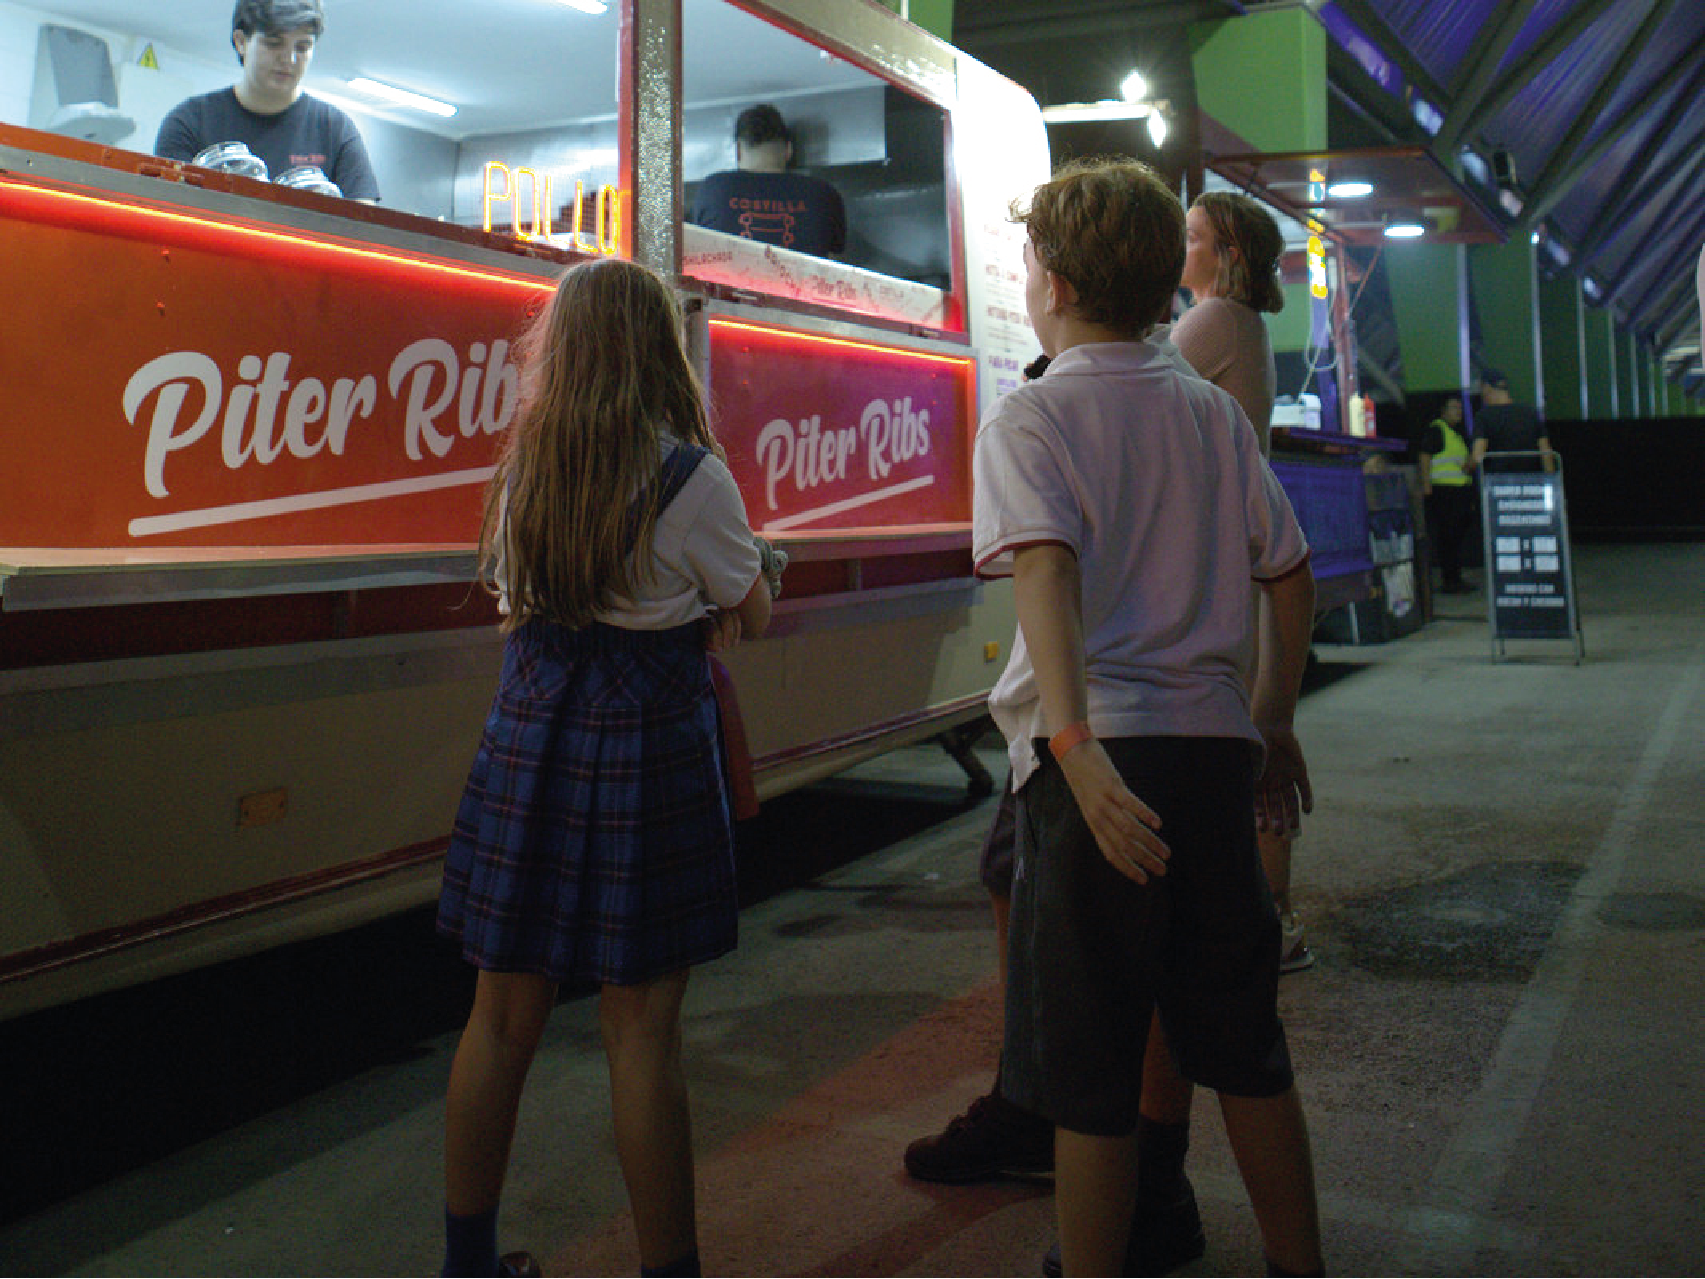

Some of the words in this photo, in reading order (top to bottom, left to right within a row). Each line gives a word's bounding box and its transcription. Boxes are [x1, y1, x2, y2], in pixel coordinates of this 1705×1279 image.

[483, 161, 618, 256] POLLO
[123, 351, 377, 499] Piter
[388, 338, 520, 461] Rib
[756, 414, 857, 511] Piter
[860, 395, 930, 481] Ribs
